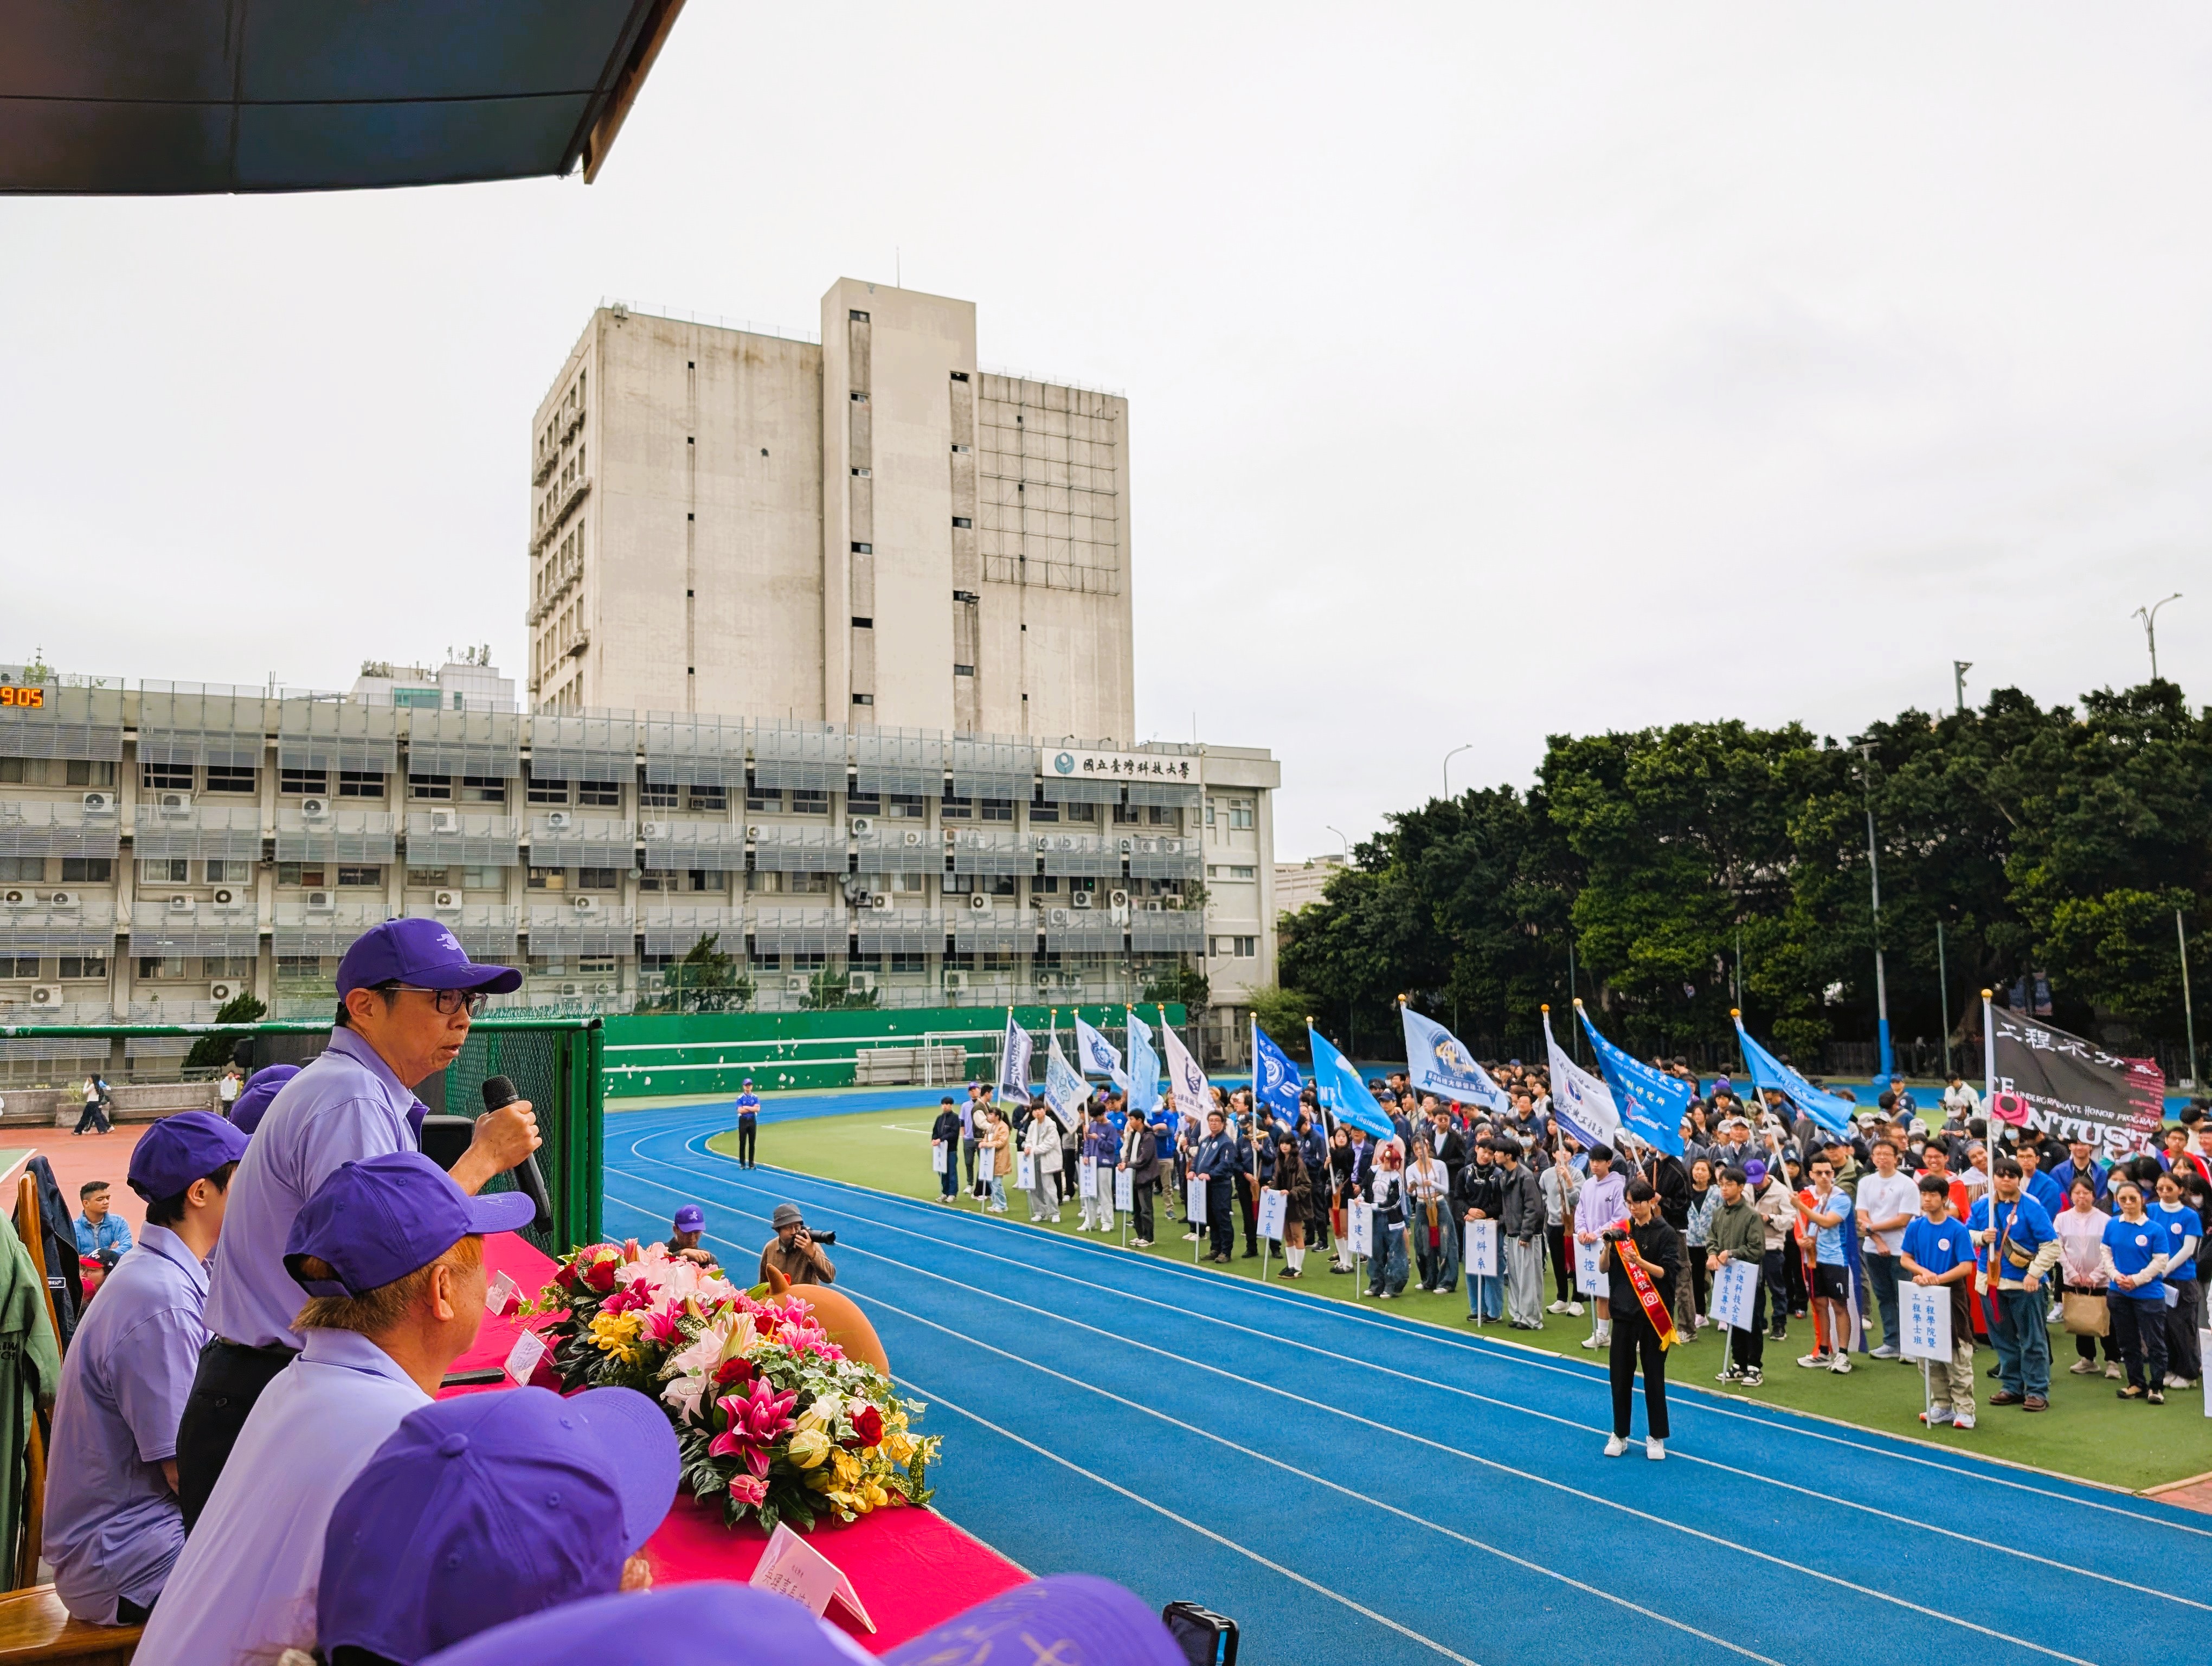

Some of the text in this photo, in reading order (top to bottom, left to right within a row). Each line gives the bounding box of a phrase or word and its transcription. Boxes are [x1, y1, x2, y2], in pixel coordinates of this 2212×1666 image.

[2022, 1106, 2153, 1154] NTUST
[1265, 1194, 1276, 1235] 化工系
[1476, 1223, 1487, 1270] 材料系
[1912, 1293, 1922, 1344] 工程學士班
[1925, 1296, 1936, 1348] 工程學院暨
